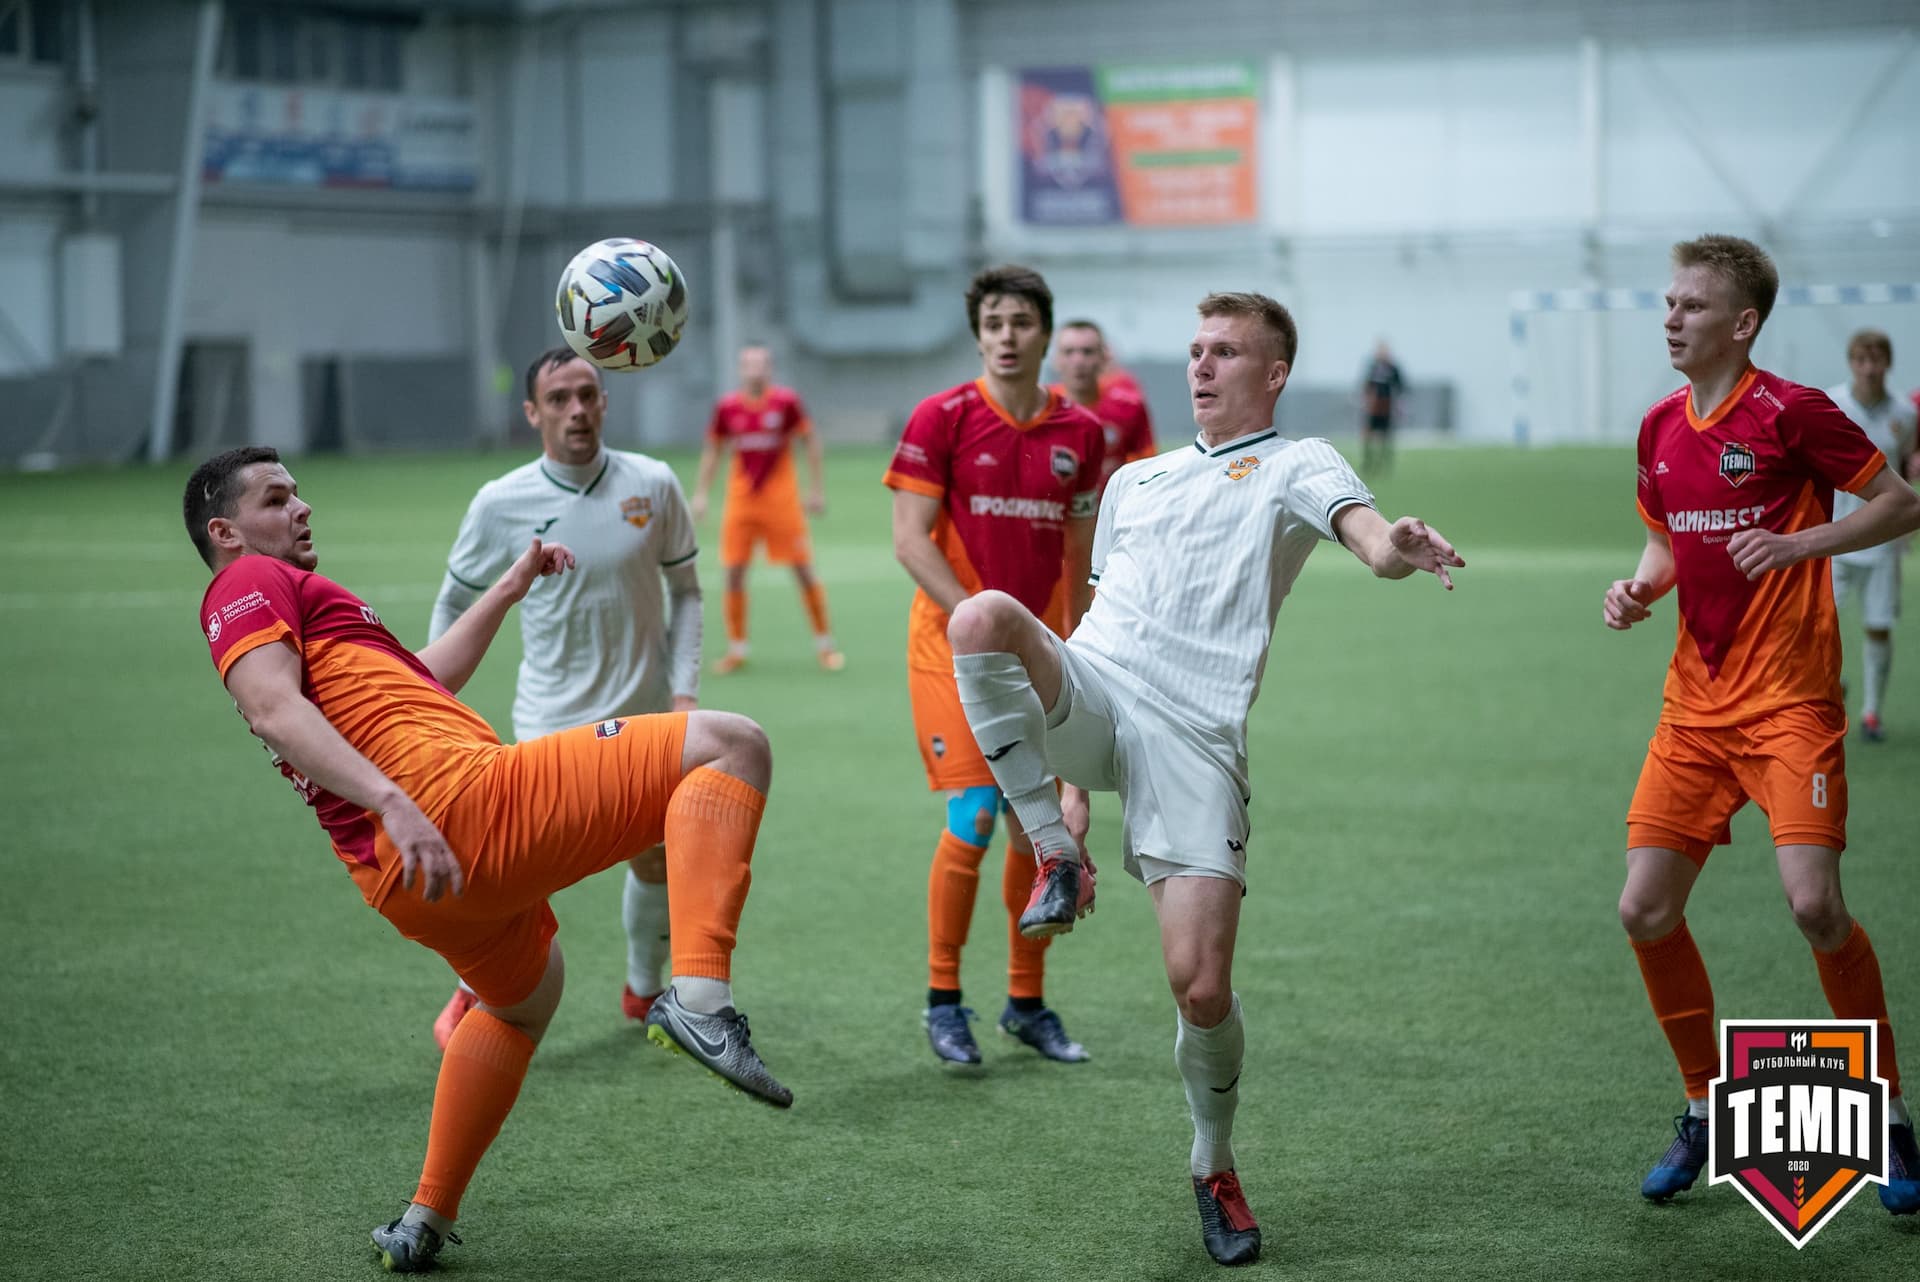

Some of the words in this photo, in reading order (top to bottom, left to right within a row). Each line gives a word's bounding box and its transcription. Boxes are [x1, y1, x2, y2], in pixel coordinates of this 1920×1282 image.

[1723, 453, 1751, 471] ТЕМП
[224, 598, 265, 621] поколен
[1812, 773, 1827, 808] 8
